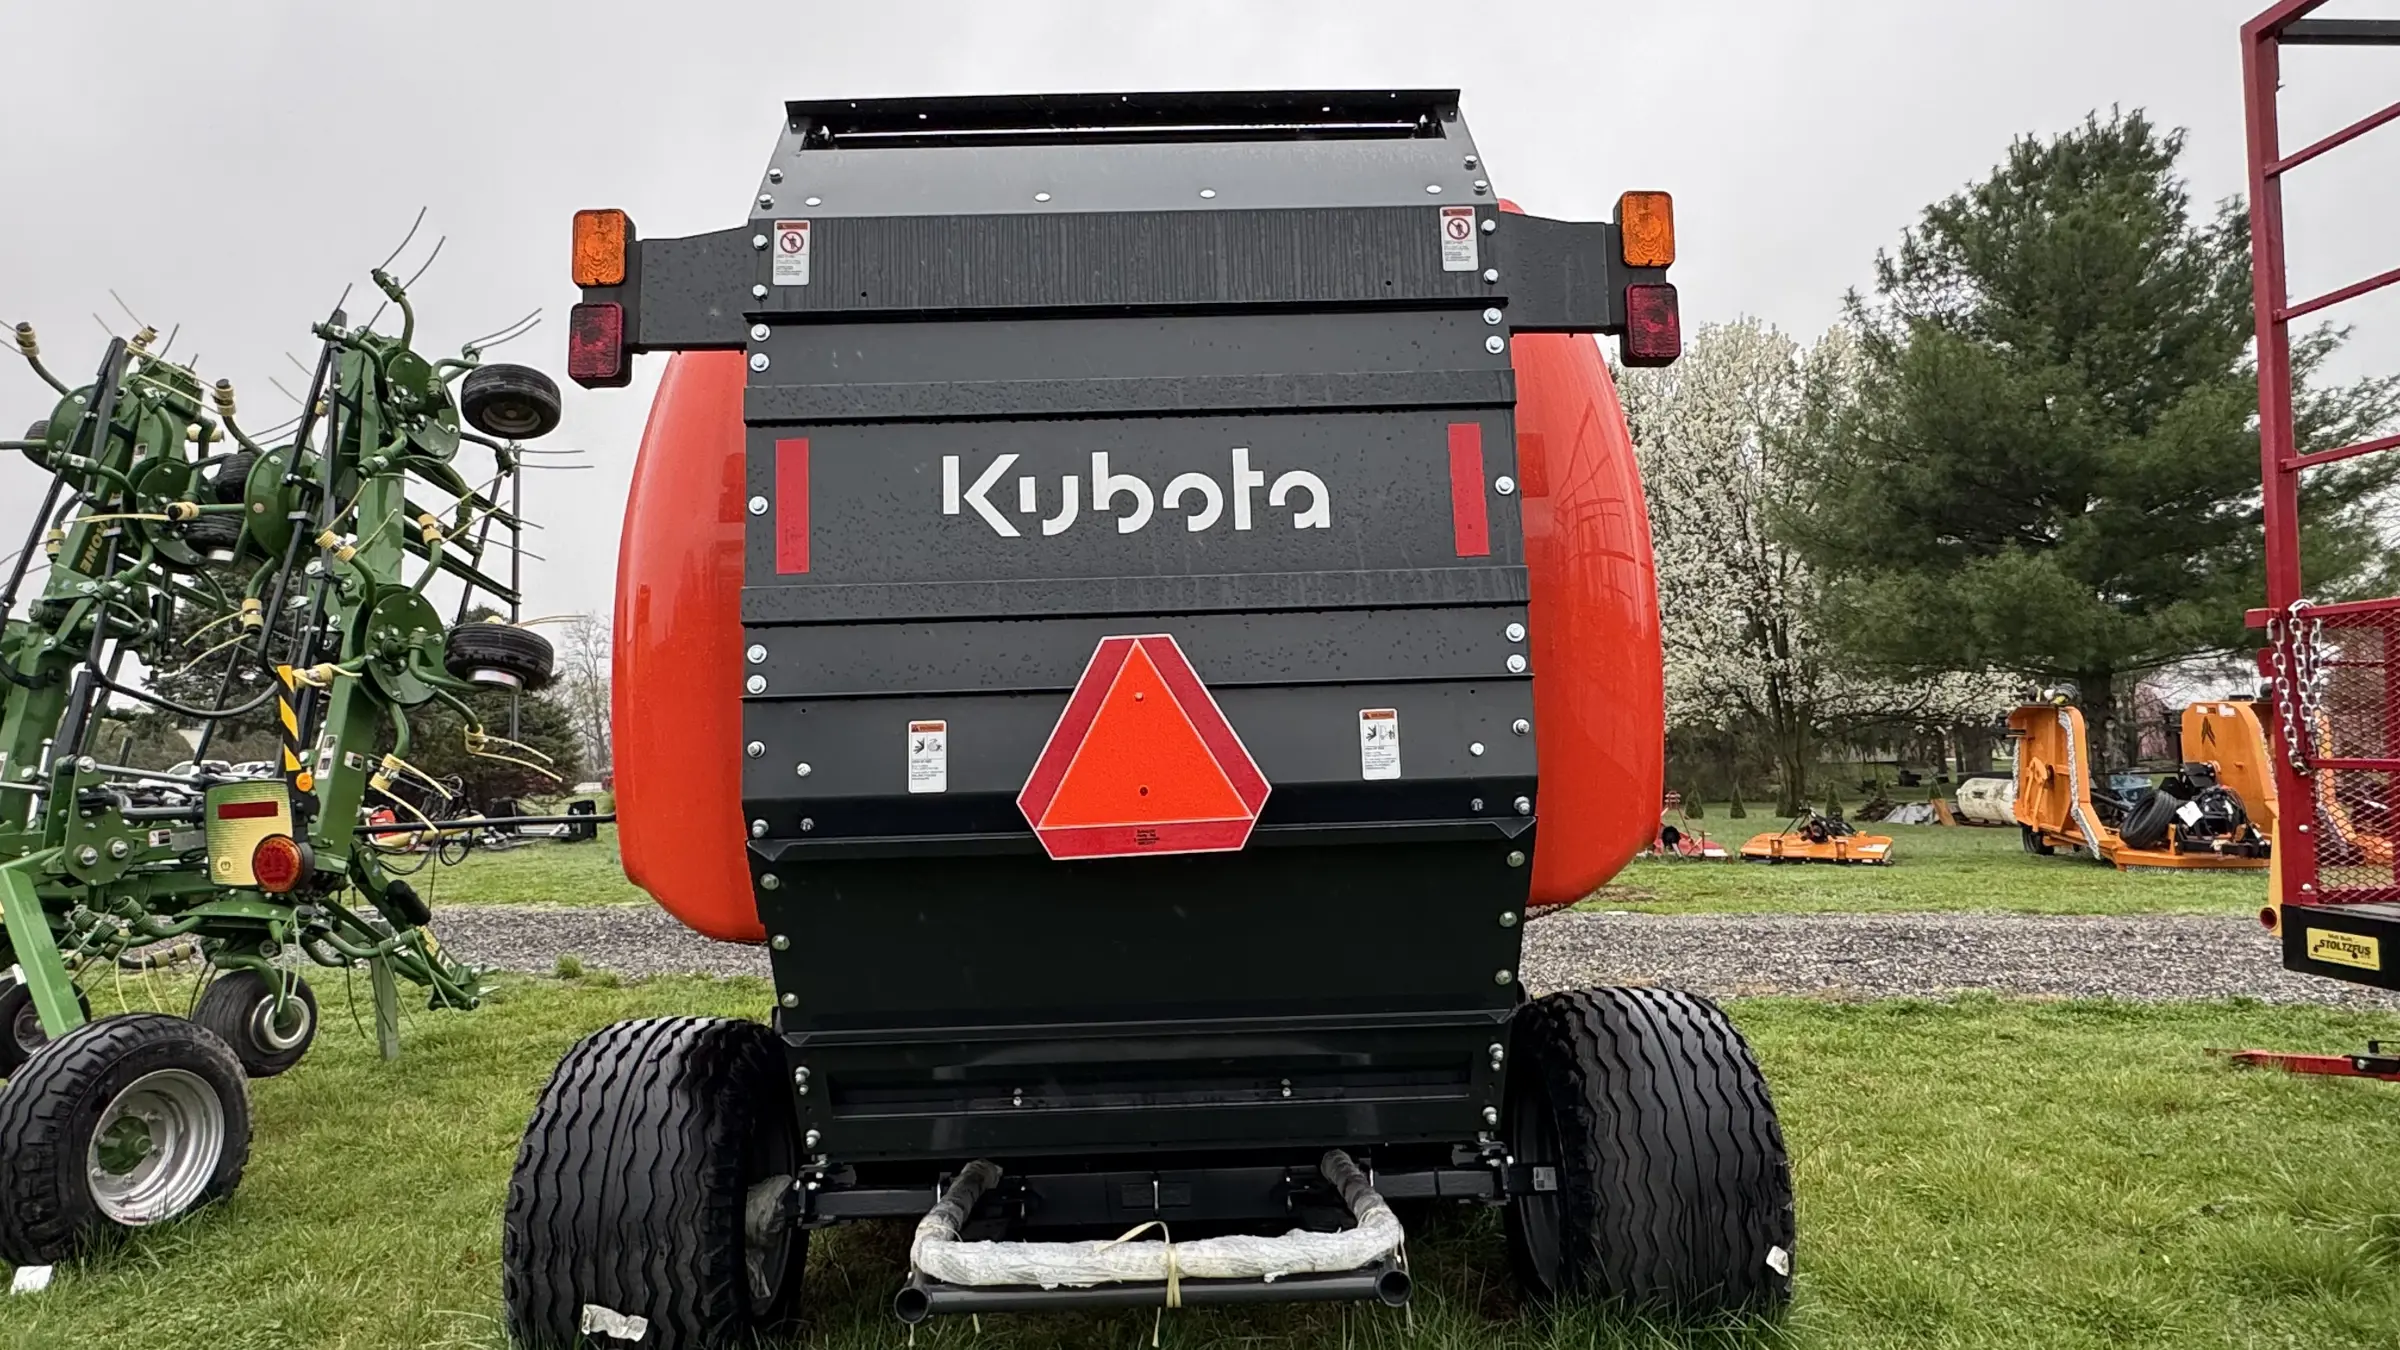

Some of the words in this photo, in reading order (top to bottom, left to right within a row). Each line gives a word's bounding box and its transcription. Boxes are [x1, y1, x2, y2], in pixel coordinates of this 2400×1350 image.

[942, 447, 1331, 537] Kubota
[80, 520, 109, 574] RONE
[2320, 939, 2372, 956] STOLTZFUS
